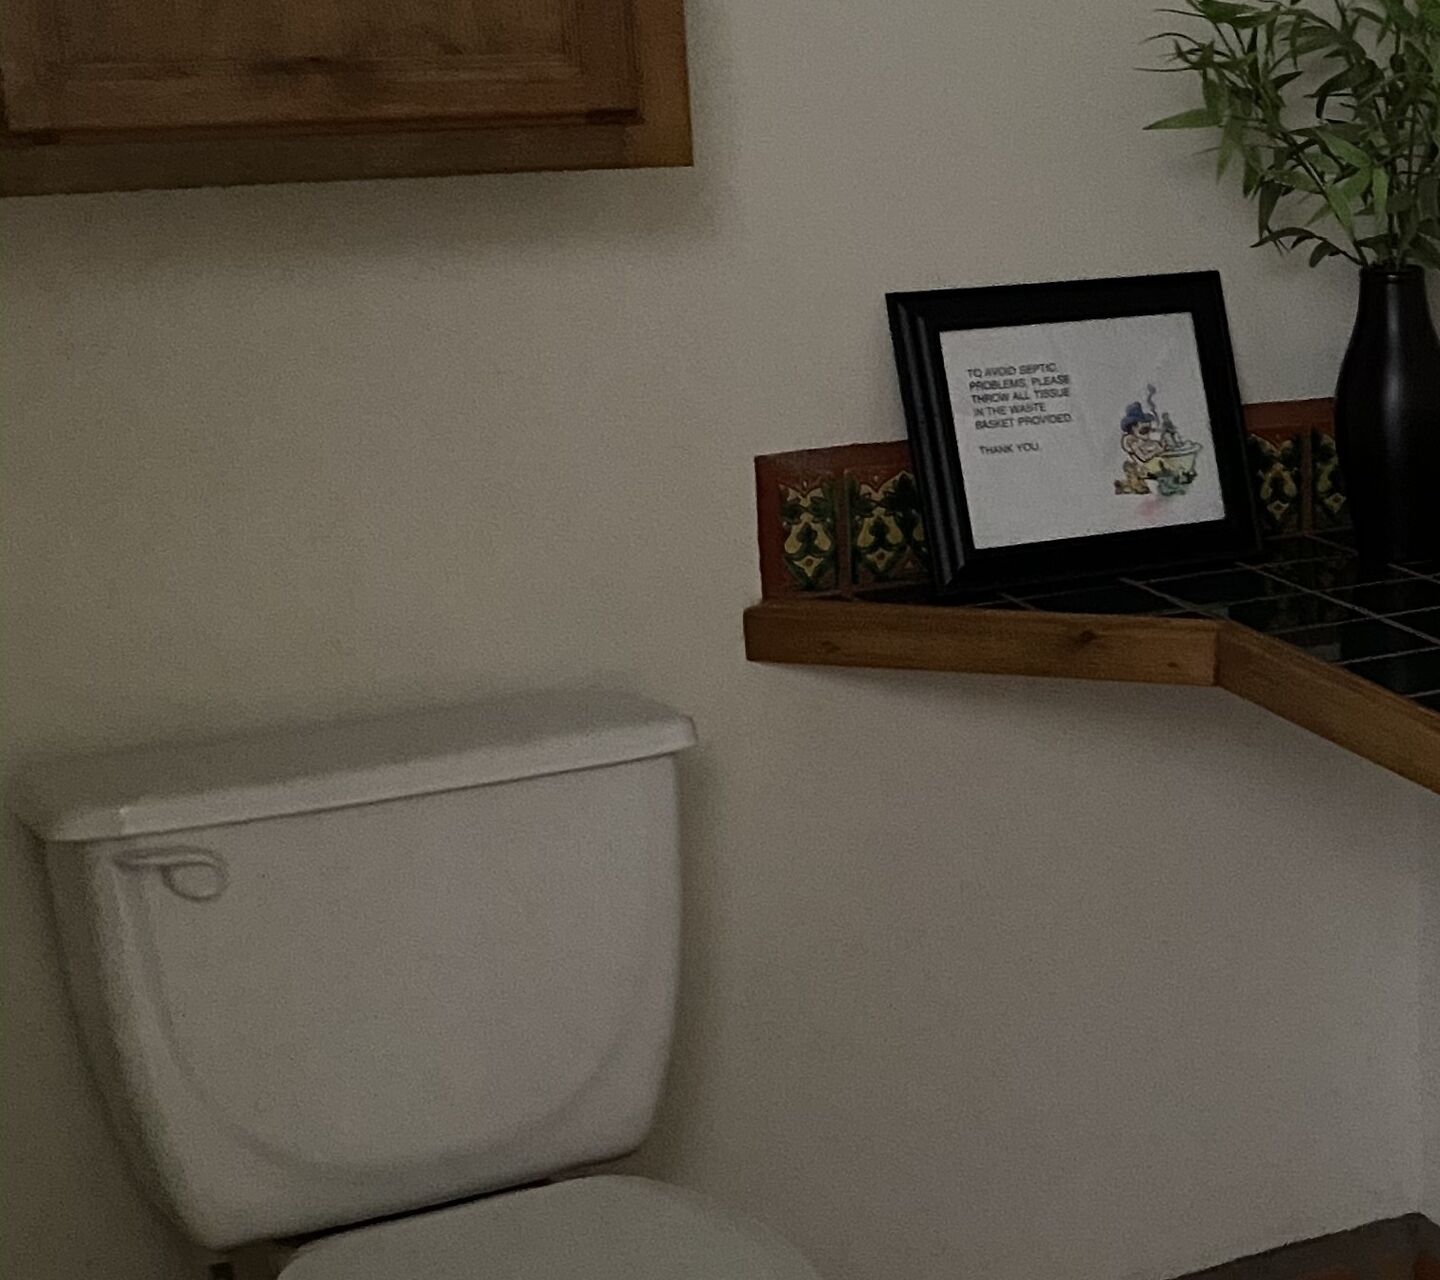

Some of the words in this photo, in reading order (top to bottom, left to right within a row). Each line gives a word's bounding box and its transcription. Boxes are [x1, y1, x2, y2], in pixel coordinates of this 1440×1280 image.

[967, 368, 982, 378] TO
[985, 366, 1016, 376] AVOID
[1018, 363, 1057, 375] SEPTIC
[1031, 374, 1070, 386] PLEASE
[971, 393, 1010, 403] THROW
[1013, 391, 1030, 401] ALL
[1034, 387, 1070, 399] TISSUE
[974, 408, 984, 417] IN
[986, 405, 1007, 416] THE
[1009, 403, 1046, 414] WASTE
[975, 418, 1014, 430] BASKET
[979, 443, 1014, 455] THANK
